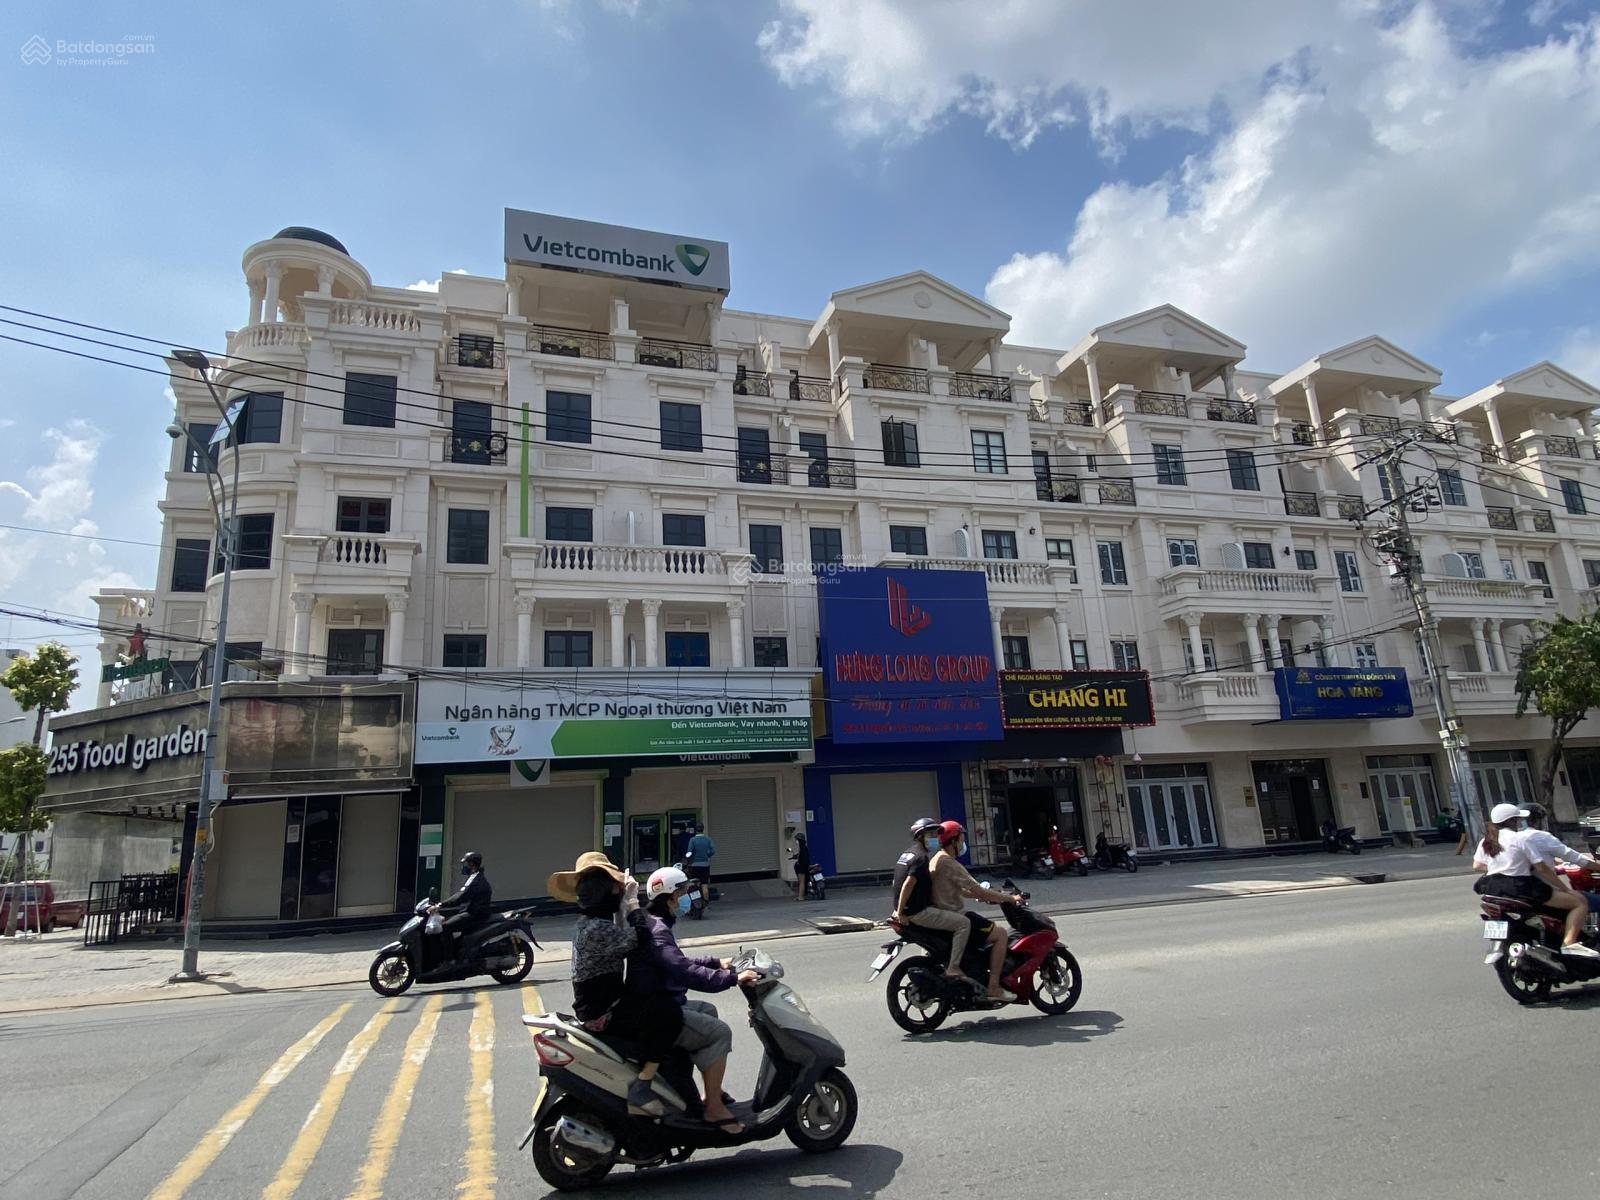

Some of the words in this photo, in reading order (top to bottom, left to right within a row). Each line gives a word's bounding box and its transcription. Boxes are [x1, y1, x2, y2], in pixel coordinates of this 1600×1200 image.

[523, 233, 675, 273] Vietcombank
[886, 655, 932, 682] LONG
[935, 655, 990, 682] GROUP
[1028, 688, 1100, 708] CHANG
[1104, 688, 1128, 707] HI
[445, 704, 493, 722] Ngân
[497, 704, 541, 721] hàng
[545, 702, 600, 717] TMCP
[605, 701, 653, 718] Ngoại
[657, 701, 713, 717] thương
[717, 700, 749, 716] Việt
[752, 700, 788, 714] Nam
[671, 720, 687, 729] Đến
[689, 719, 739, 729] Vietcombank,
[740, 719, 755, 728] Vay
[756, 719, 781, 728] nhanh,
[782, 719, 791, 727] lãi
[792, 718, 808, 728] thấp
[48, 742, 79, 774] 255
[82, 734, 129, 769] food
[132, 724, 208, 770] garden
